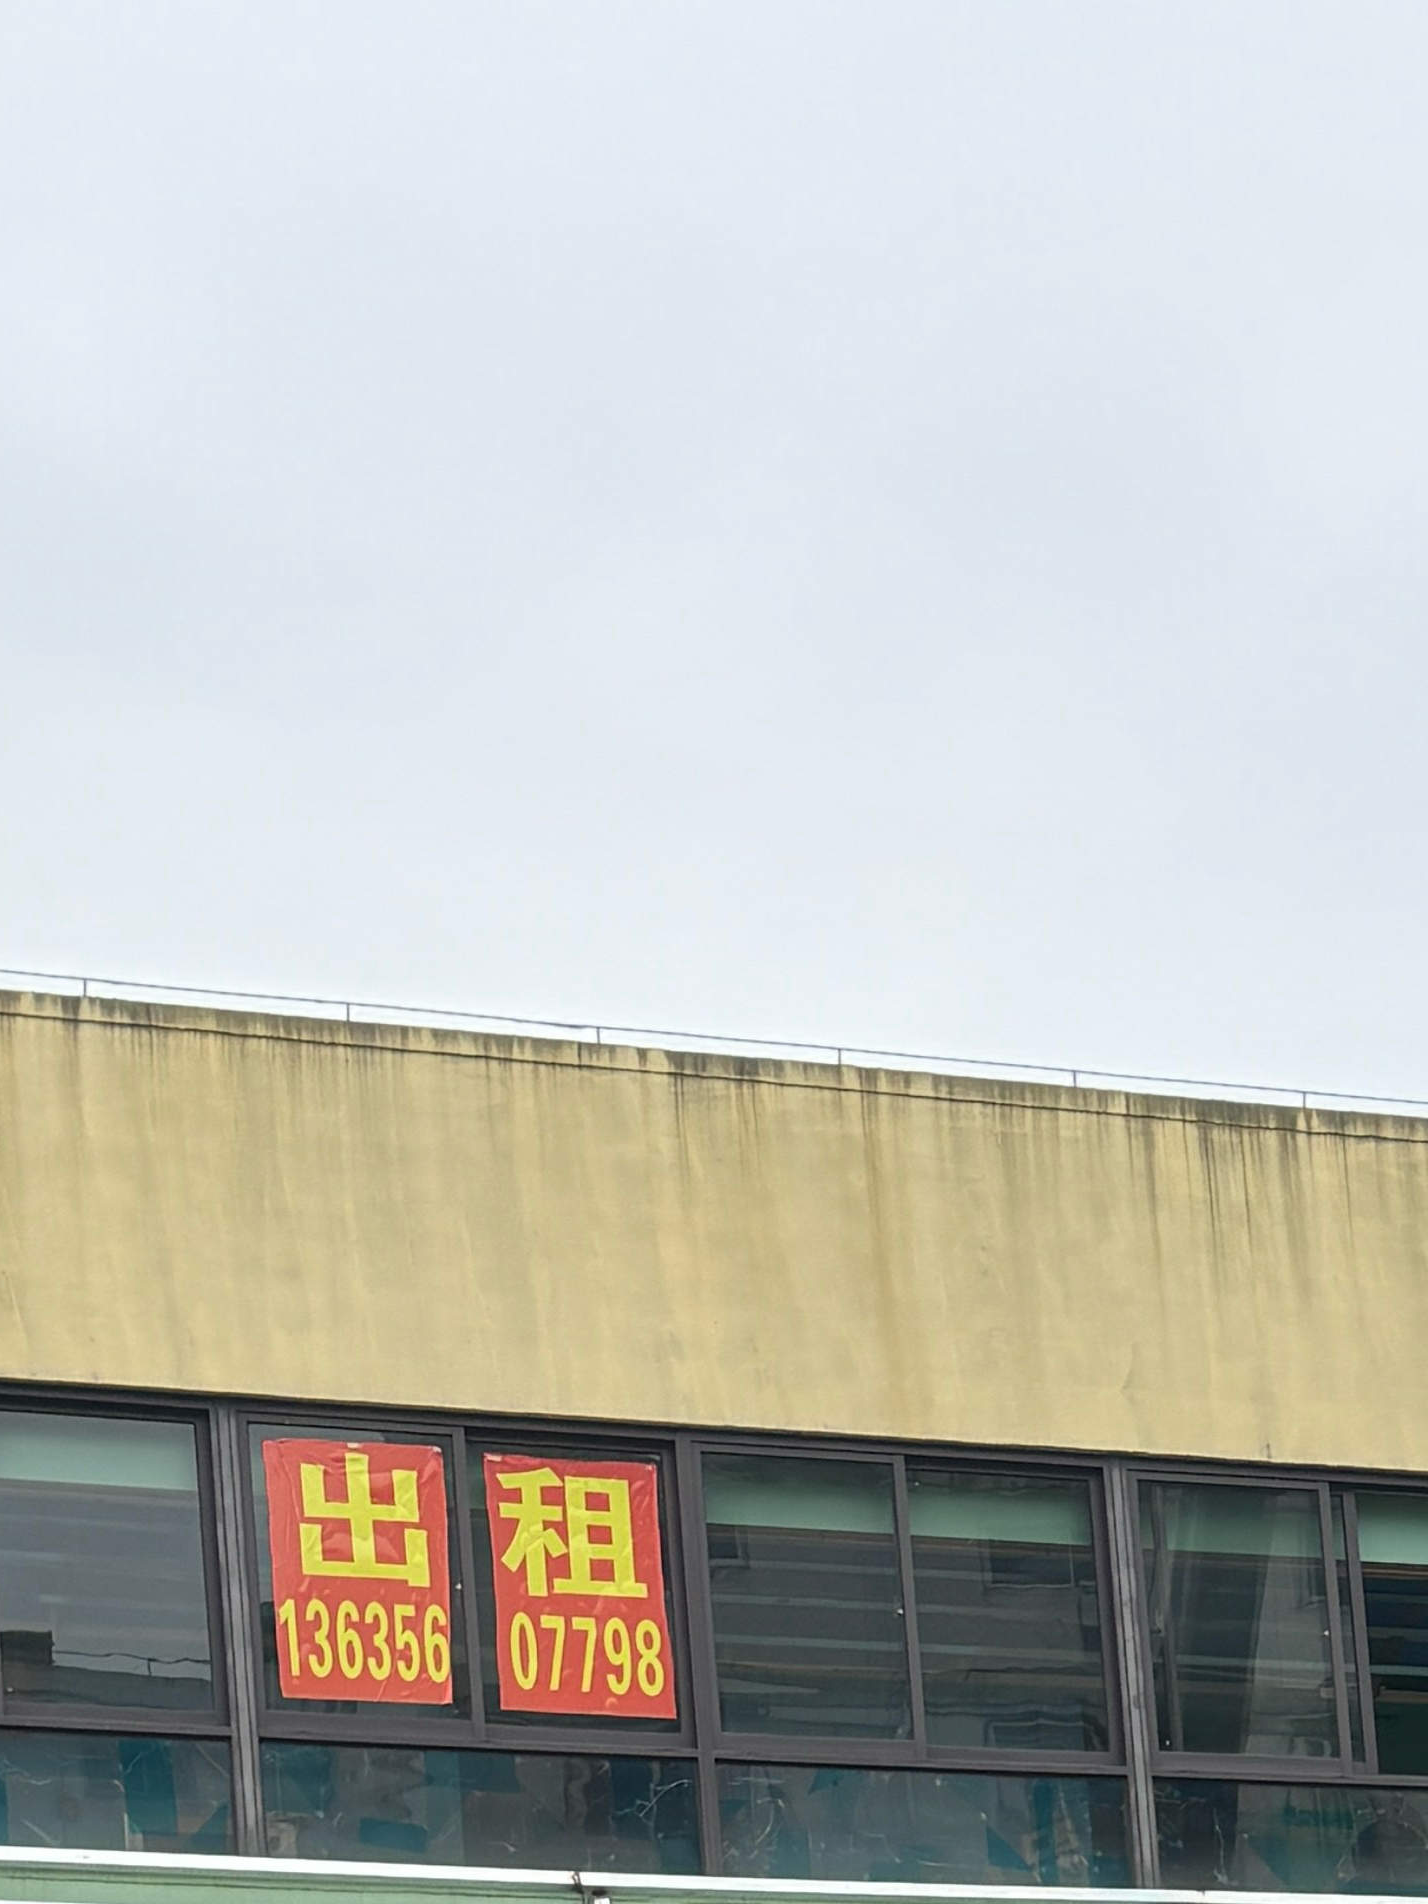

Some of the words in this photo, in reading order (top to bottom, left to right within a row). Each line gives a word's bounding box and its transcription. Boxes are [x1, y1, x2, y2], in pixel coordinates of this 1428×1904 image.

[300, 1453, 430, 1588] 出
[497, 1467, 648, 1598] 租
[279, 1599, 450, 1684] 136356
[510, 1612, 665, 1696] 07798
